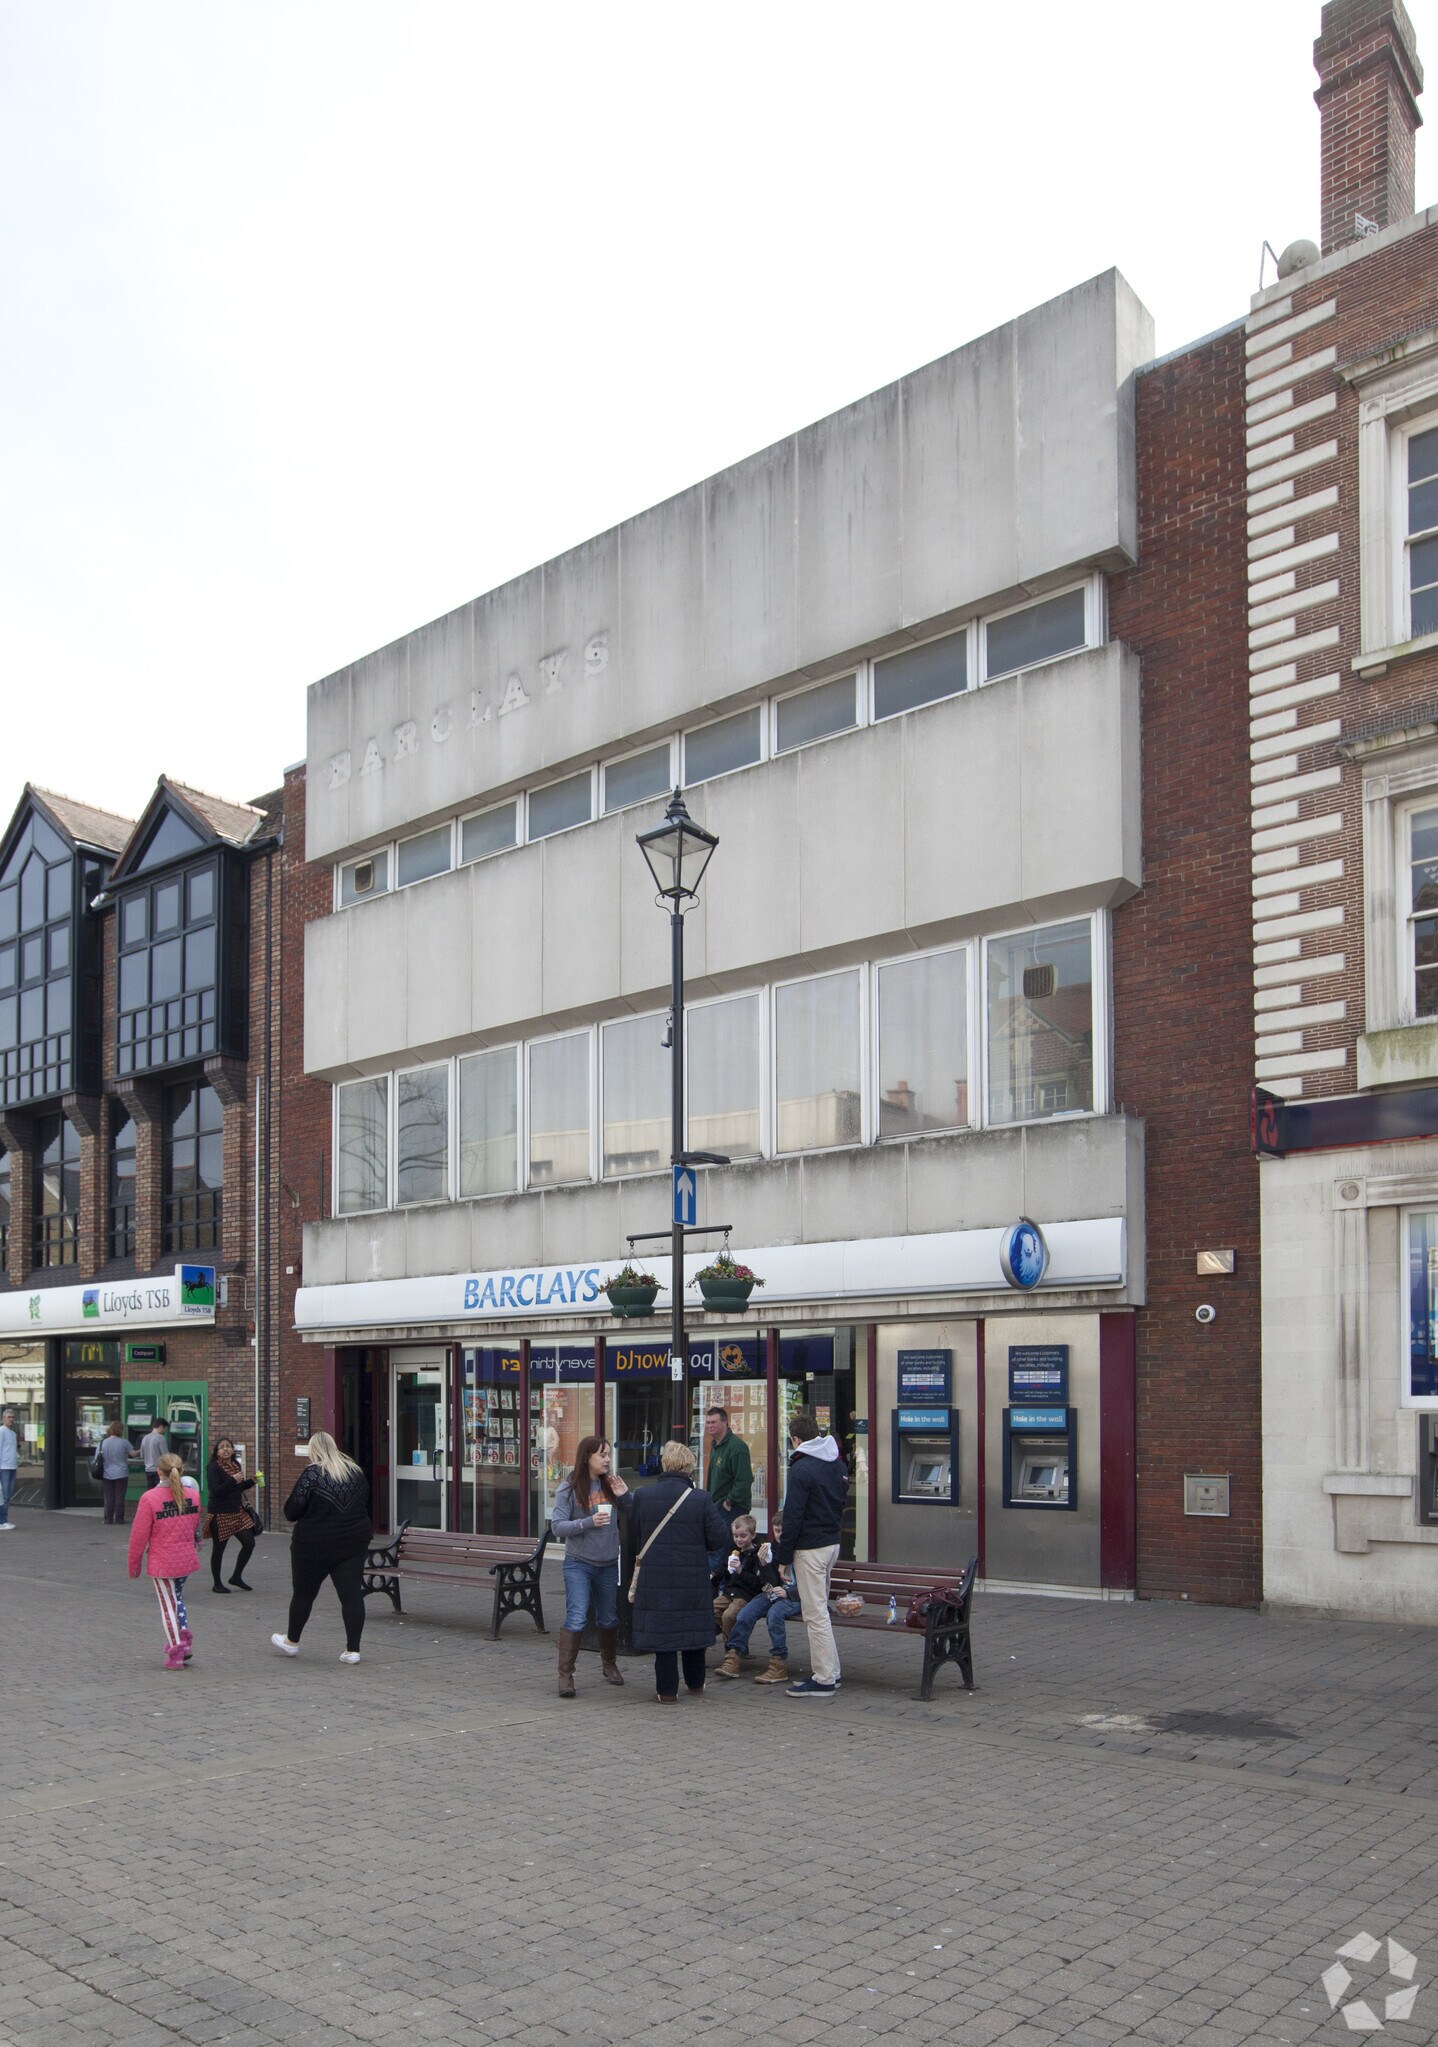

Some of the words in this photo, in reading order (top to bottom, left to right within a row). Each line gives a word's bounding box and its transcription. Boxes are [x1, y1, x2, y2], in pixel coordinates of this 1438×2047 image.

[328, 633, 610, 790] BARCLAYS
[103, 1289, 142, 1317] Lloyds
[146, 1288, 170, 1308] TSB
[464, 1268, 600, 1309] BARCLAYS
[184, 1306, 201, 1315] Lloyds
